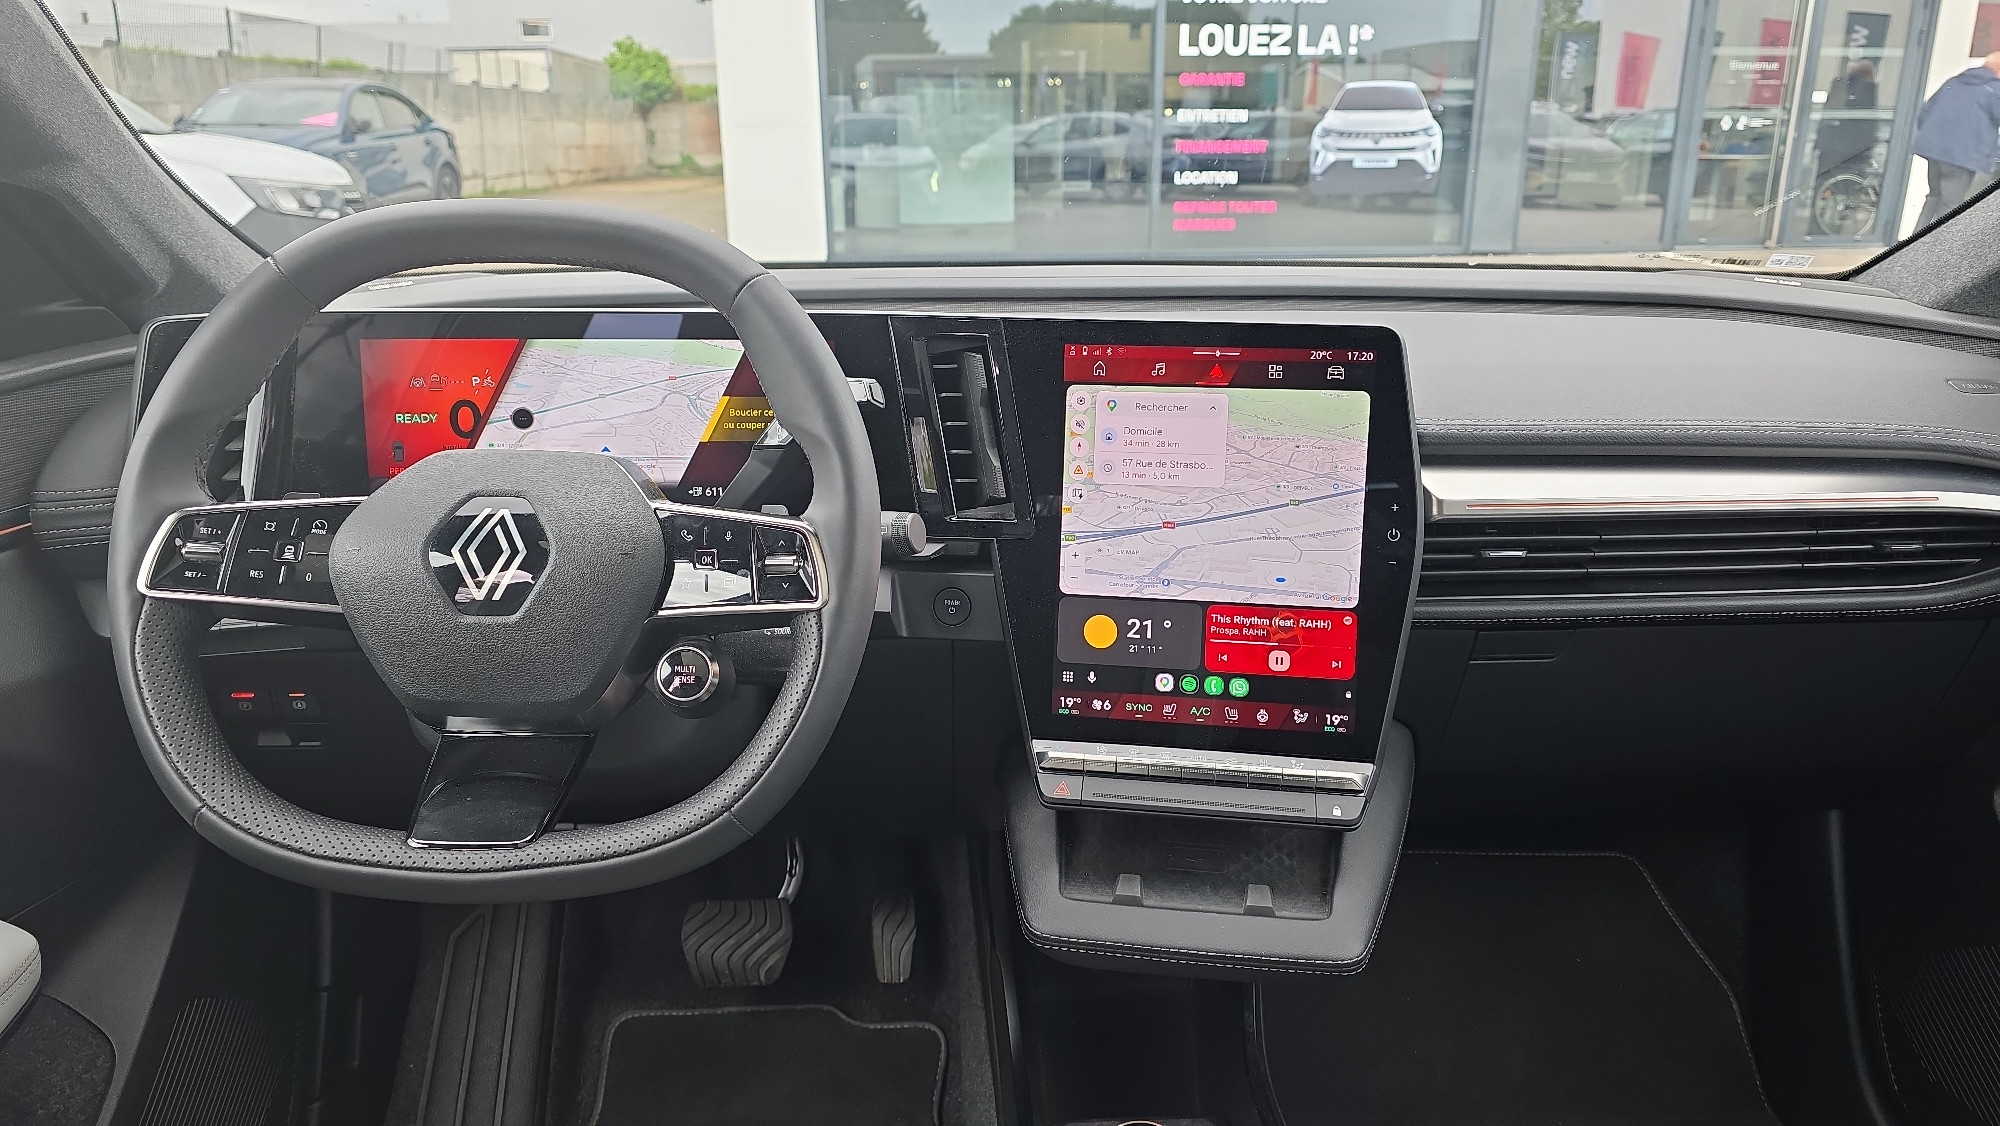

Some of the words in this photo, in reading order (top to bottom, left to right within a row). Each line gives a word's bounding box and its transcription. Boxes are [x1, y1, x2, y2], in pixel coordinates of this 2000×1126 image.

[1179, 23, 1293, 57] LOUEZ
[1297, 23, 1343, 56] LA
[1179, 72, 1246, 87] GARANTIE
[1177, 108, 1249, 123] ENTRETIEN
[1174, 170, 1239, 185] LOCATION
[1347, 351, 1374, 361] 17:20
[1135, 402, 1188, 412] Rechercher
[729, 408, 762, 417] Boucler
[395, 413, 438, 424] READY
[736, 422, 765, 431] couper
[1123, 426, 1163, 436] Domicile
[1135, 440, 1150, 448] min
[1156, 440, 1166, 448] 28
[1168, 440, 1180, 448] km
[1122, 459, 1133, 467] 57
[1135, 459, 1153, 468] Rue
[1155, 459, 1167, 468] de
[1122, 471, 1130, 479] 13
[1131, 471, 1146, 479] min
[1168, 472, 1180, 480] km
[705, 486, 723, 496] 611
[701, 555, 713, 565] OK
[249, 569, 264, 579] RES
[1322, 592, 1353, 604] Google
[1211, 614, 1231, 624] This
[1233, 615, 1270, 626] Rhythm
[1272, 617, 1296, 628] (feat.
[1299, 619, 1332, 630] RAHH)
[1242, 627, 1267, 637] RAHH
[674, 665, 696, 673] MULTI
[674, 675, 696, 684] SENSE
[1125, 702, 1153, 712] SYNC
[1189, 706, 1211, 716] A/C
